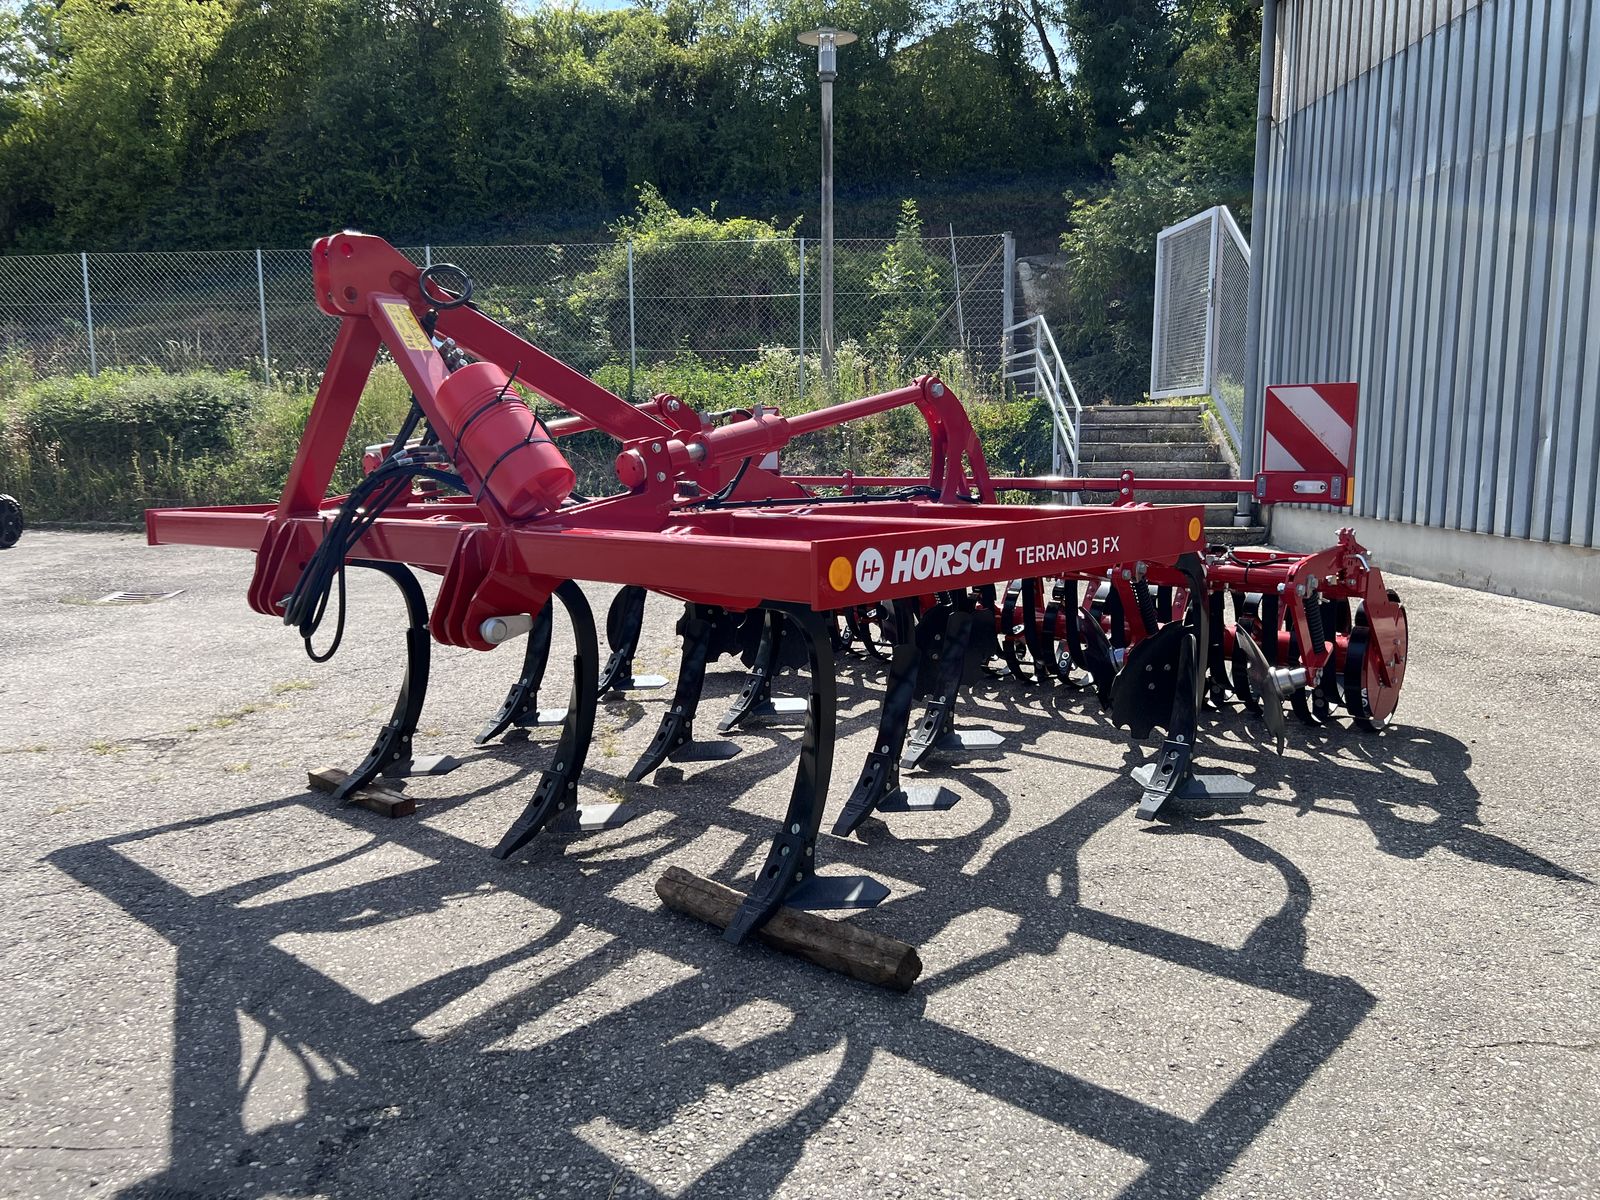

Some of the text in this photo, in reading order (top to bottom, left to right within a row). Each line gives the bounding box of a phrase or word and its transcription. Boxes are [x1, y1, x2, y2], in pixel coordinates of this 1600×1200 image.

[890, 535, 1121, 584] HORSCH TERRANO 3 FX
